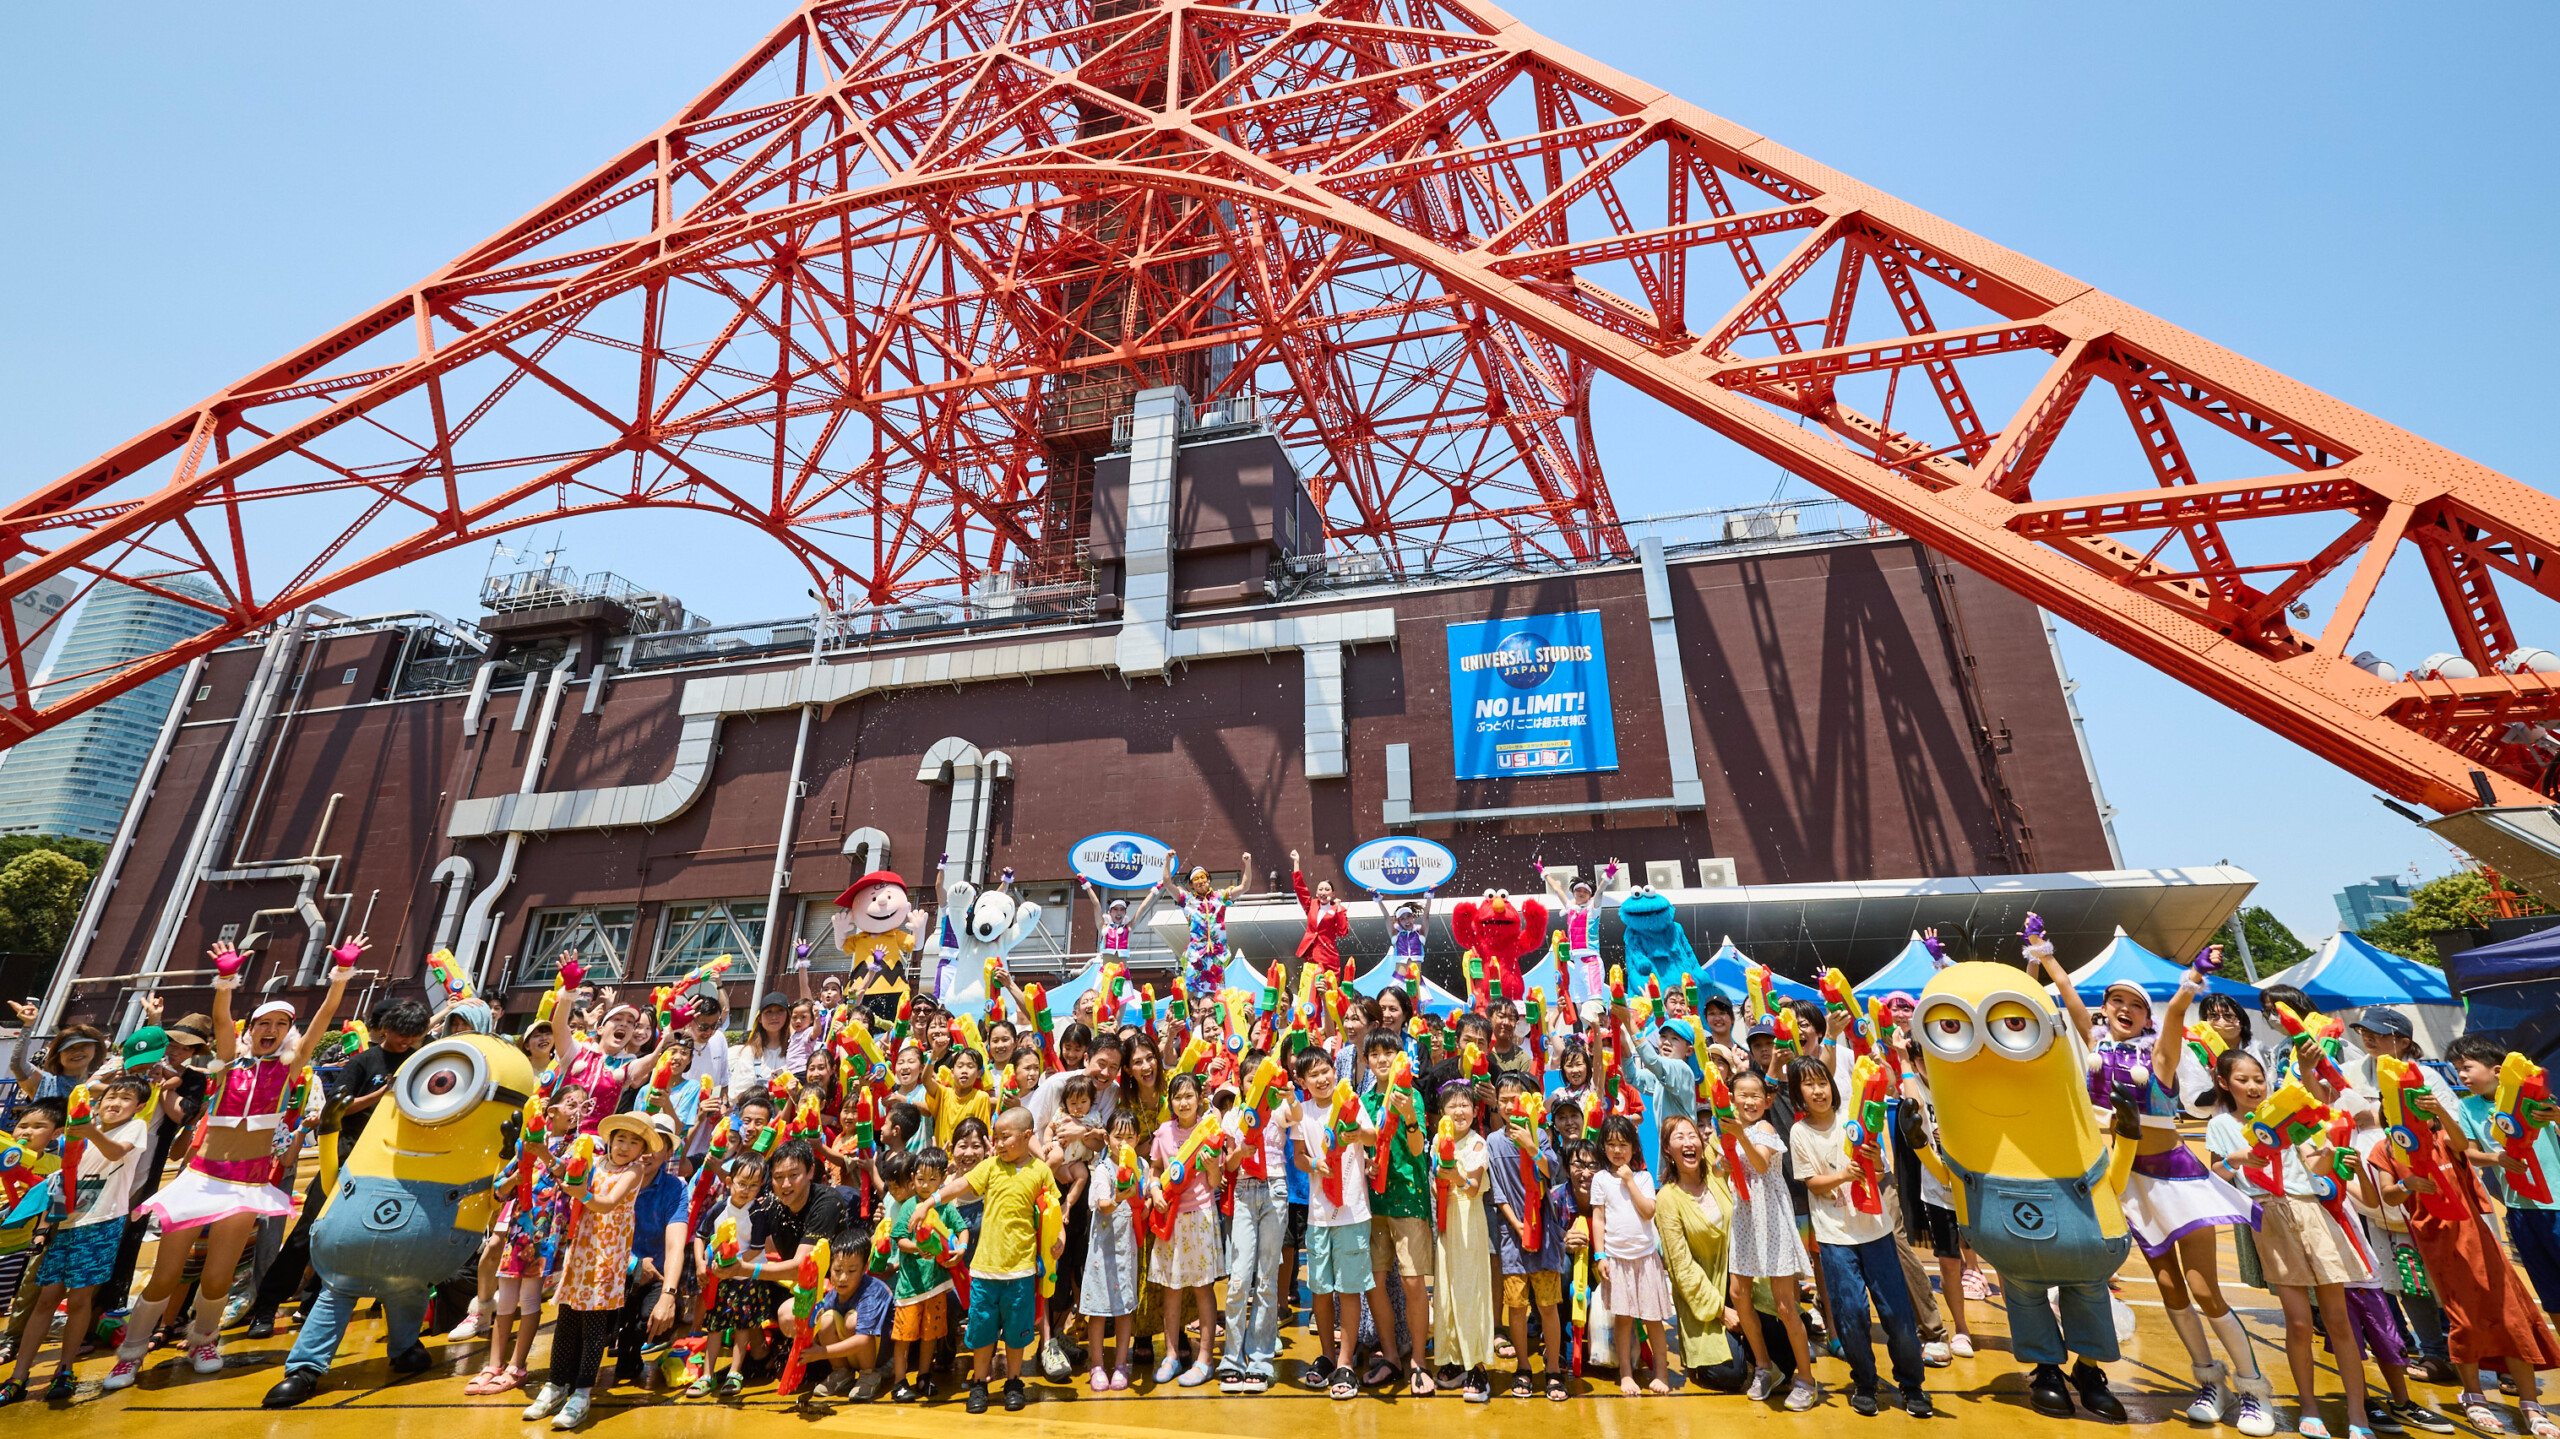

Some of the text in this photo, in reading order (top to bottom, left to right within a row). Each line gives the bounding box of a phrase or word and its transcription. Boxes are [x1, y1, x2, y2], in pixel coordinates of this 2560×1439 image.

[1460, 645, 1592, 672] UNIVERSAL STUDIOS
[1504, 664, 1548, 676] JAPAN
[1475, 691, 1585, 718] NO LIMIT!
[1083, 851, 1165, 868] UNIVERSAL STUDIOS
[1110, 863, 1138, 871] JAPAN
[1359, 856, 1442, 871] UNIVERSAL STUDIOS
[1387, 867, 1415, 875] JAPAN
